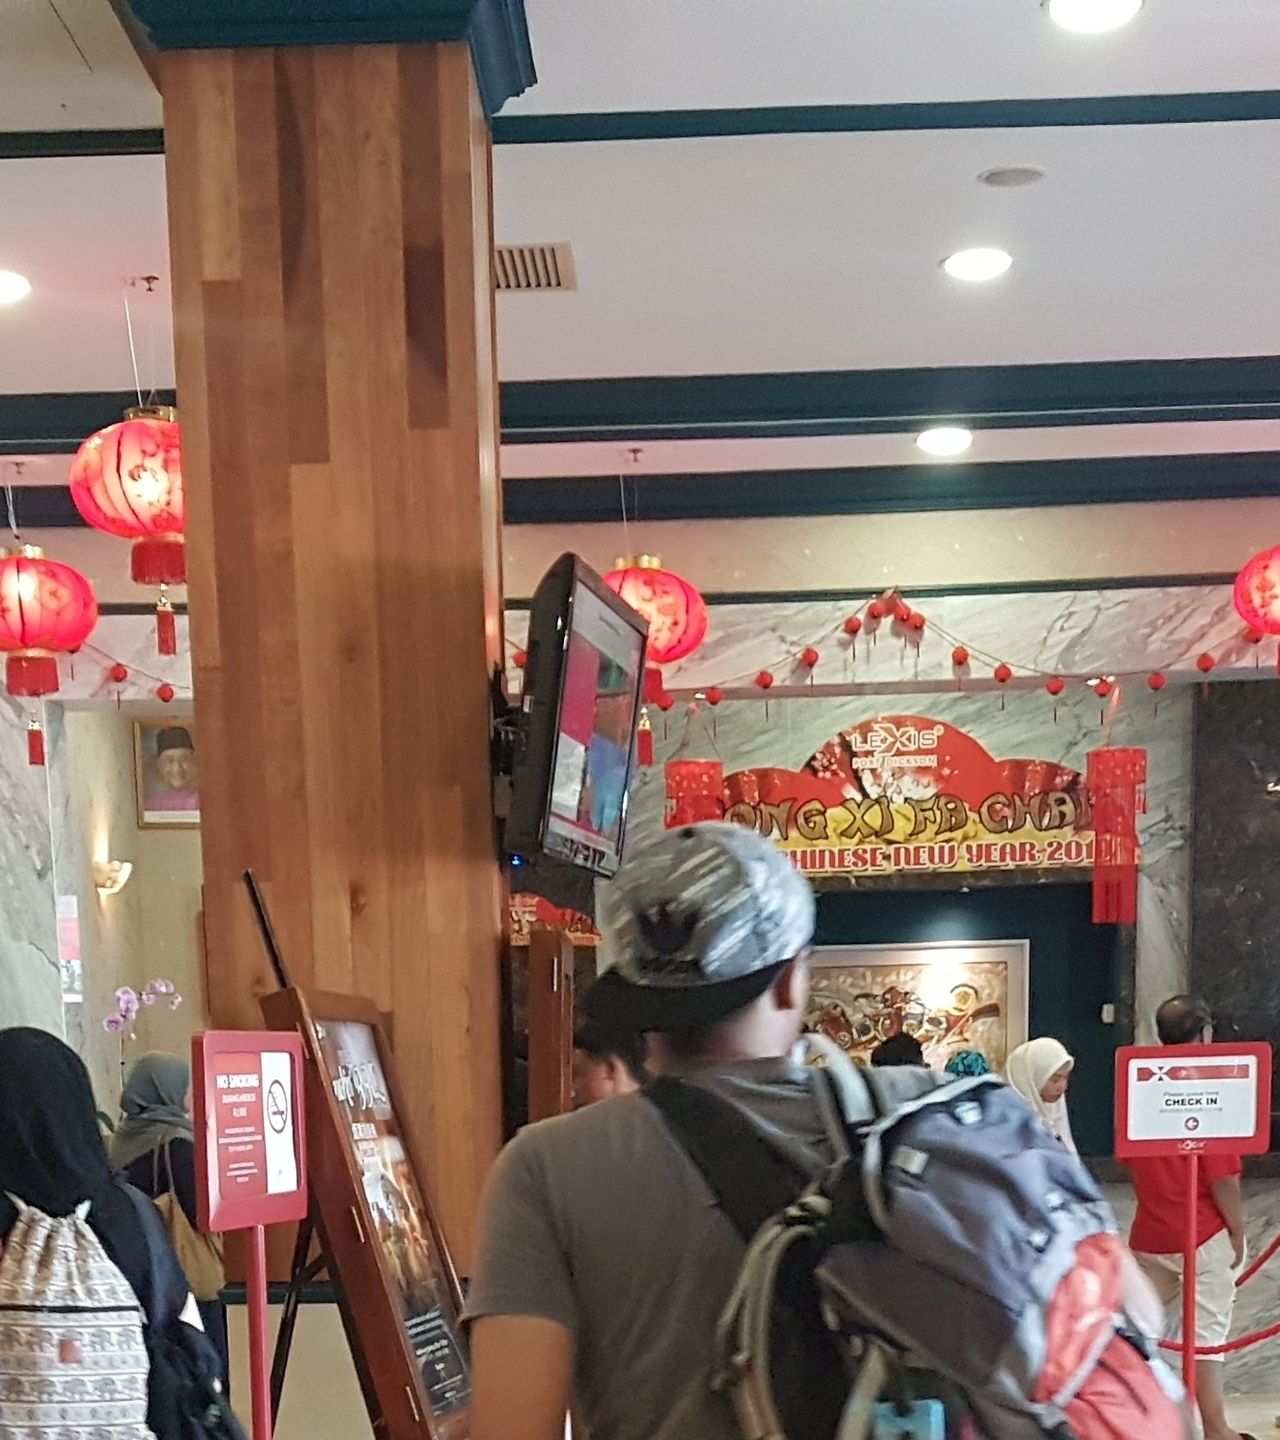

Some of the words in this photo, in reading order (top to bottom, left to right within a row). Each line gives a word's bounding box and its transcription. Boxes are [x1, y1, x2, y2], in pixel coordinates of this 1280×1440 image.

[851, 722, 938, 757] LEXIS
[722, 796, 829, 841] ONG
[840, 795, 895, 840] XI
[904, 793, 968, 837] FA
[790, 845, 884, 870] HINESE
[893, 845, 957, 868] NEW
[966, 840, 1038, 866] YEAR
[1046, 840, 1096, 863] 201
[1165, 1098, 1203, 1107] CHECK
[1206, 1097, 1218, 1105] IN
